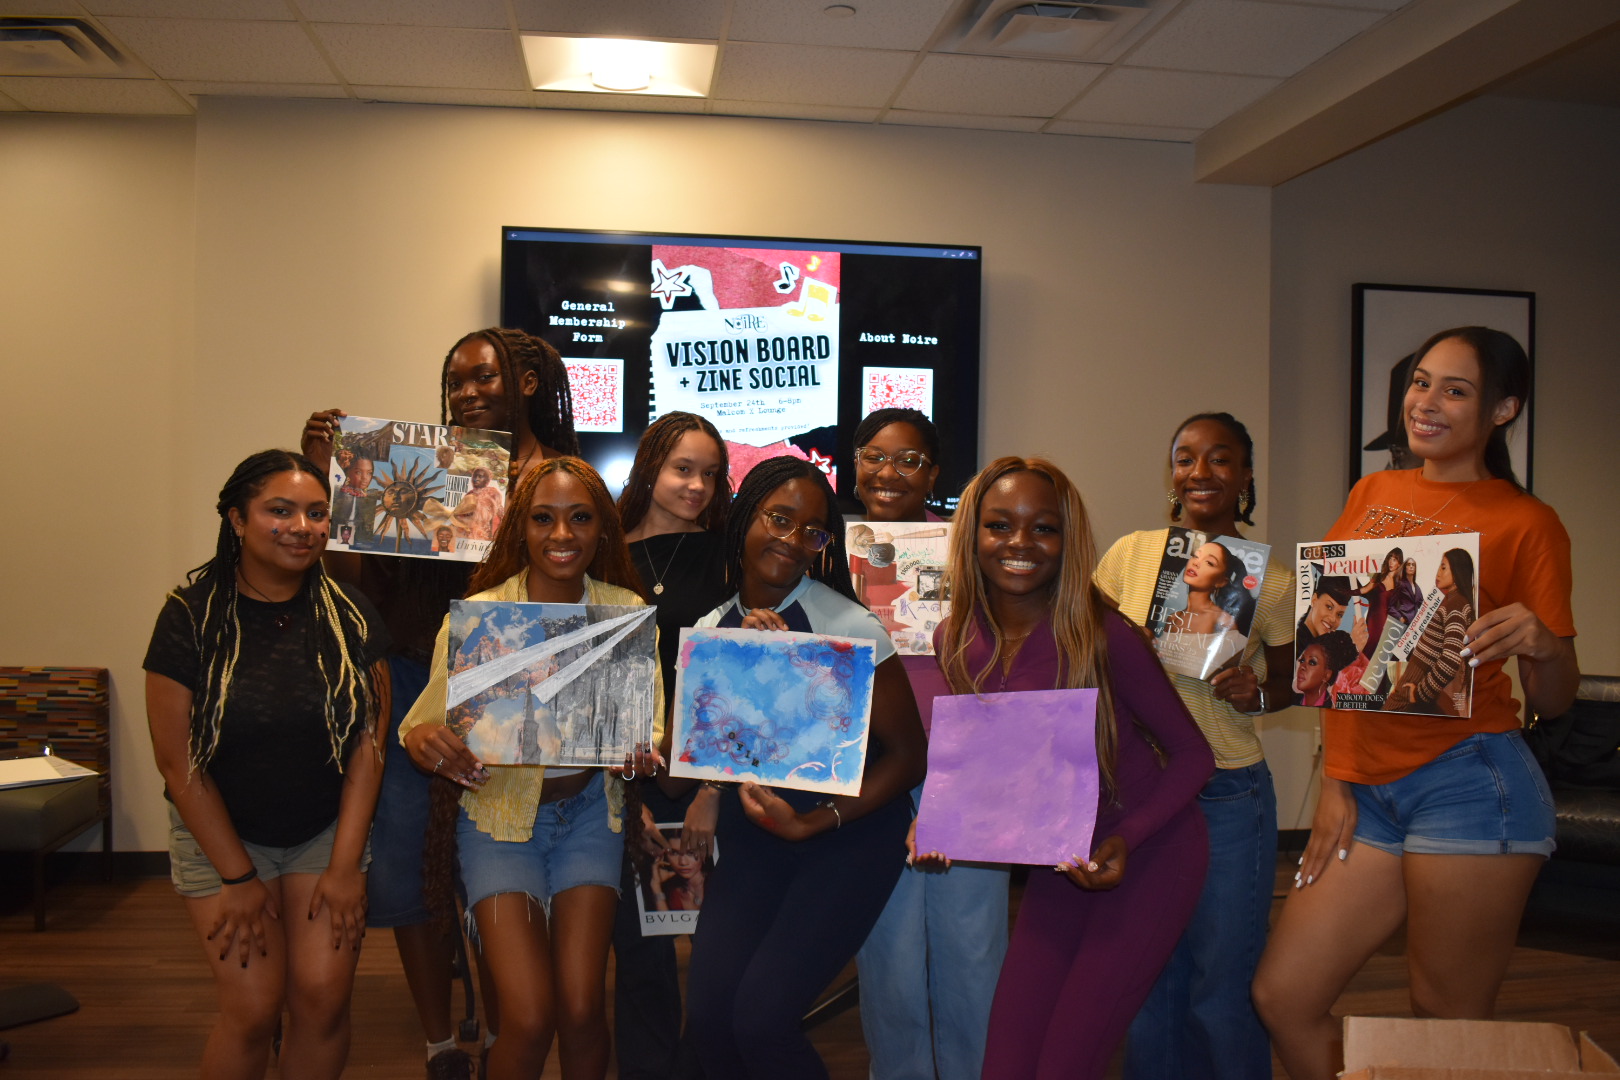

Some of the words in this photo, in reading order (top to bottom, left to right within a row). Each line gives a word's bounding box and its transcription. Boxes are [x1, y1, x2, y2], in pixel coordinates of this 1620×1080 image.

[561, 300, 615, 312] General
[549, 315, 626, 329] Membership
[572, 332, 603, 343] Form
[859, 332, 895, 343] About
[902, 334, 938, 344] Noire
[666, 338, 749, 367] VISION
[756, 335, 831, 363] BOARD
[679, 377, 690, 388] +
[696, 369, 743, 392] ZINE
[749, 365, 821, 390] SOCIAL
[700, 401, 743, 410] September
[746, 399, 766, 407] 24th
[749, 407, 755, 415] X
[758, 406, 787, 414] Lounge
[392, 422, 449, 447] STAR
[1303, 545, 1345, 559] GUESS
[1323, 552, 1380, 575] beauty
[1300, 564, 1311, 600] DIOR
[1150, 604, 1199, 629] BEST
[1397, 631, 1411, 649] Give
[1408, 600, 1430, 632] yourself
[1427, 587, 1438, 602] the
[1154, 626, 1164, 634] of
[1403, 641, 1414, 656] gift
[1412, 631, 1420, 641] of
[1418, 611, 1433, 634] great
[1430, 596, 1442, 613] hair
[1359, 664, 1385, 692] be
[1377, 616, 1406, 664] cool
[1337, 693, 1363, 702] NOBODY
[1365, 694, 1384, 702] DOES
[1343, 701, 1368, 709] BETTER
[645, 913, 699, 924] BVLG
